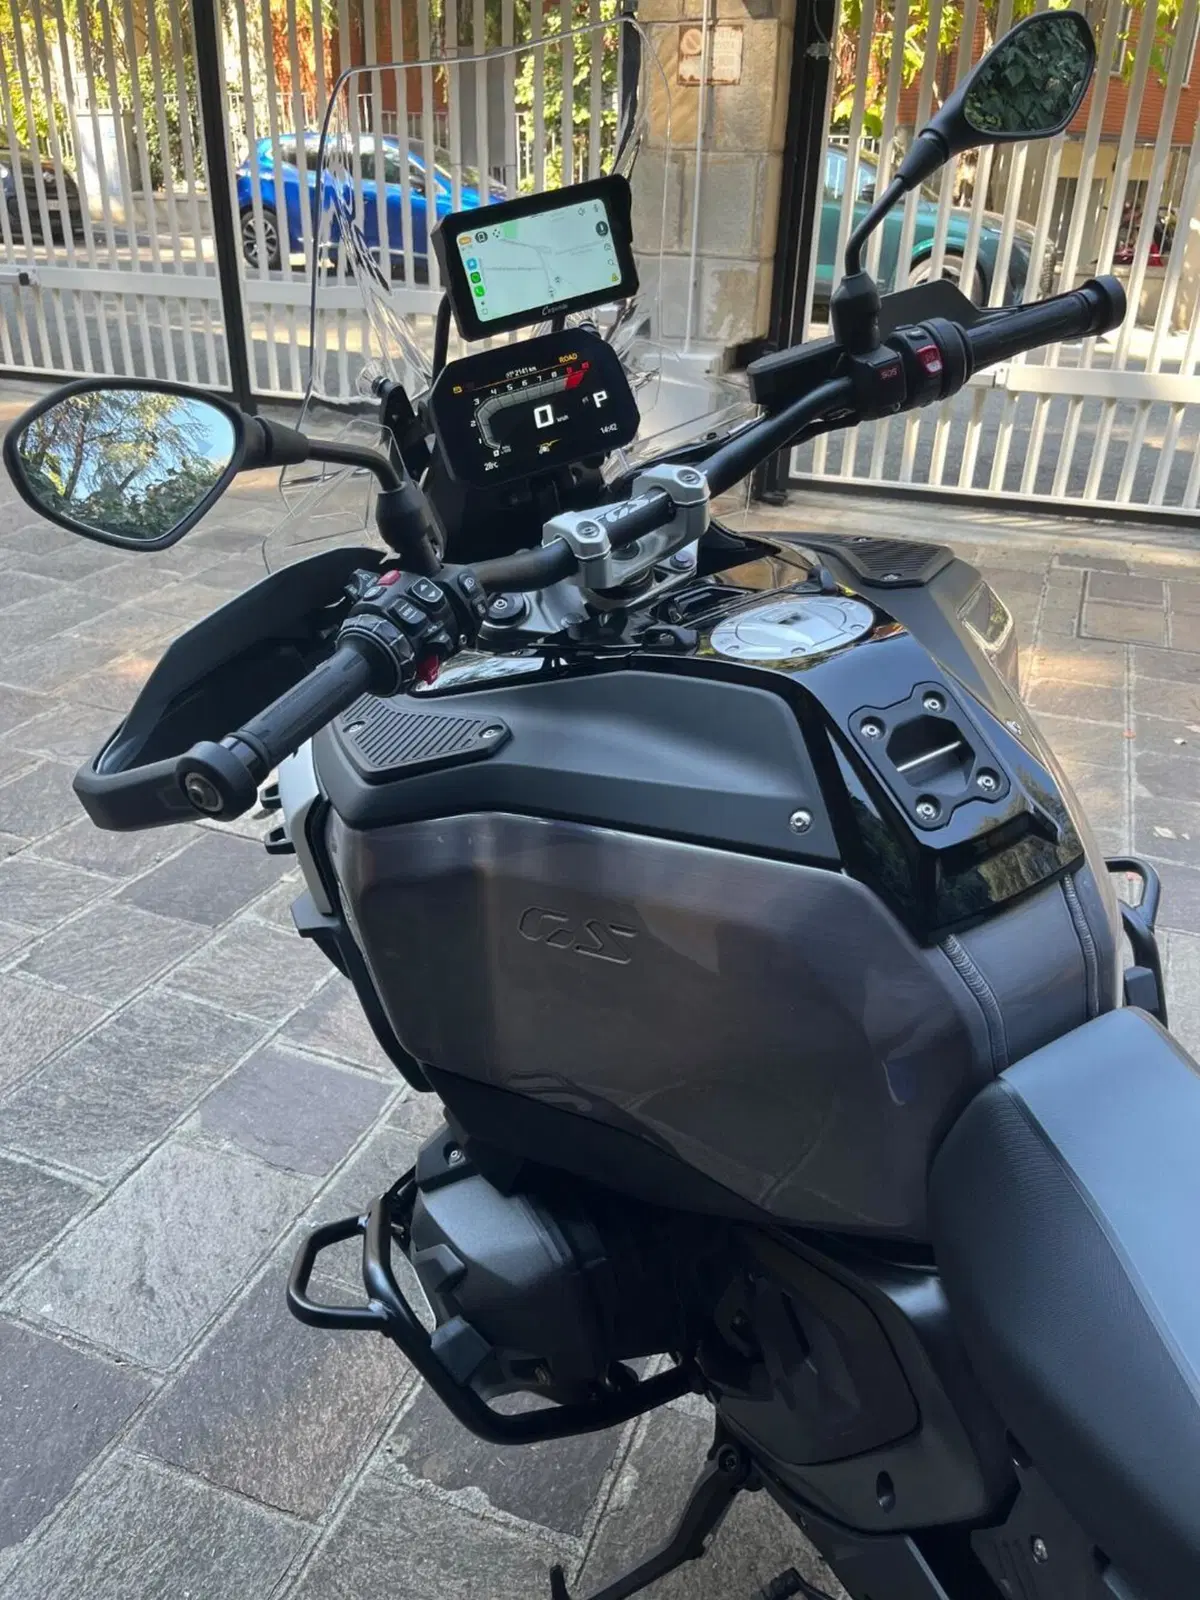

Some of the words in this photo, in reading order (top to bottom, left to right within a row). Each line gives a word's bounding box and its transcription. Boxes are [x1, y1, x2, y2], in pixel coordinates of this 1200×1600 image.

[559, 353, 578, 363] ROAD
[473, 398, 480, 406] 3
[593, 390, 608, 408] P
[534, 404, 554, 429] 0
[470, 420, 477, 428] 2
